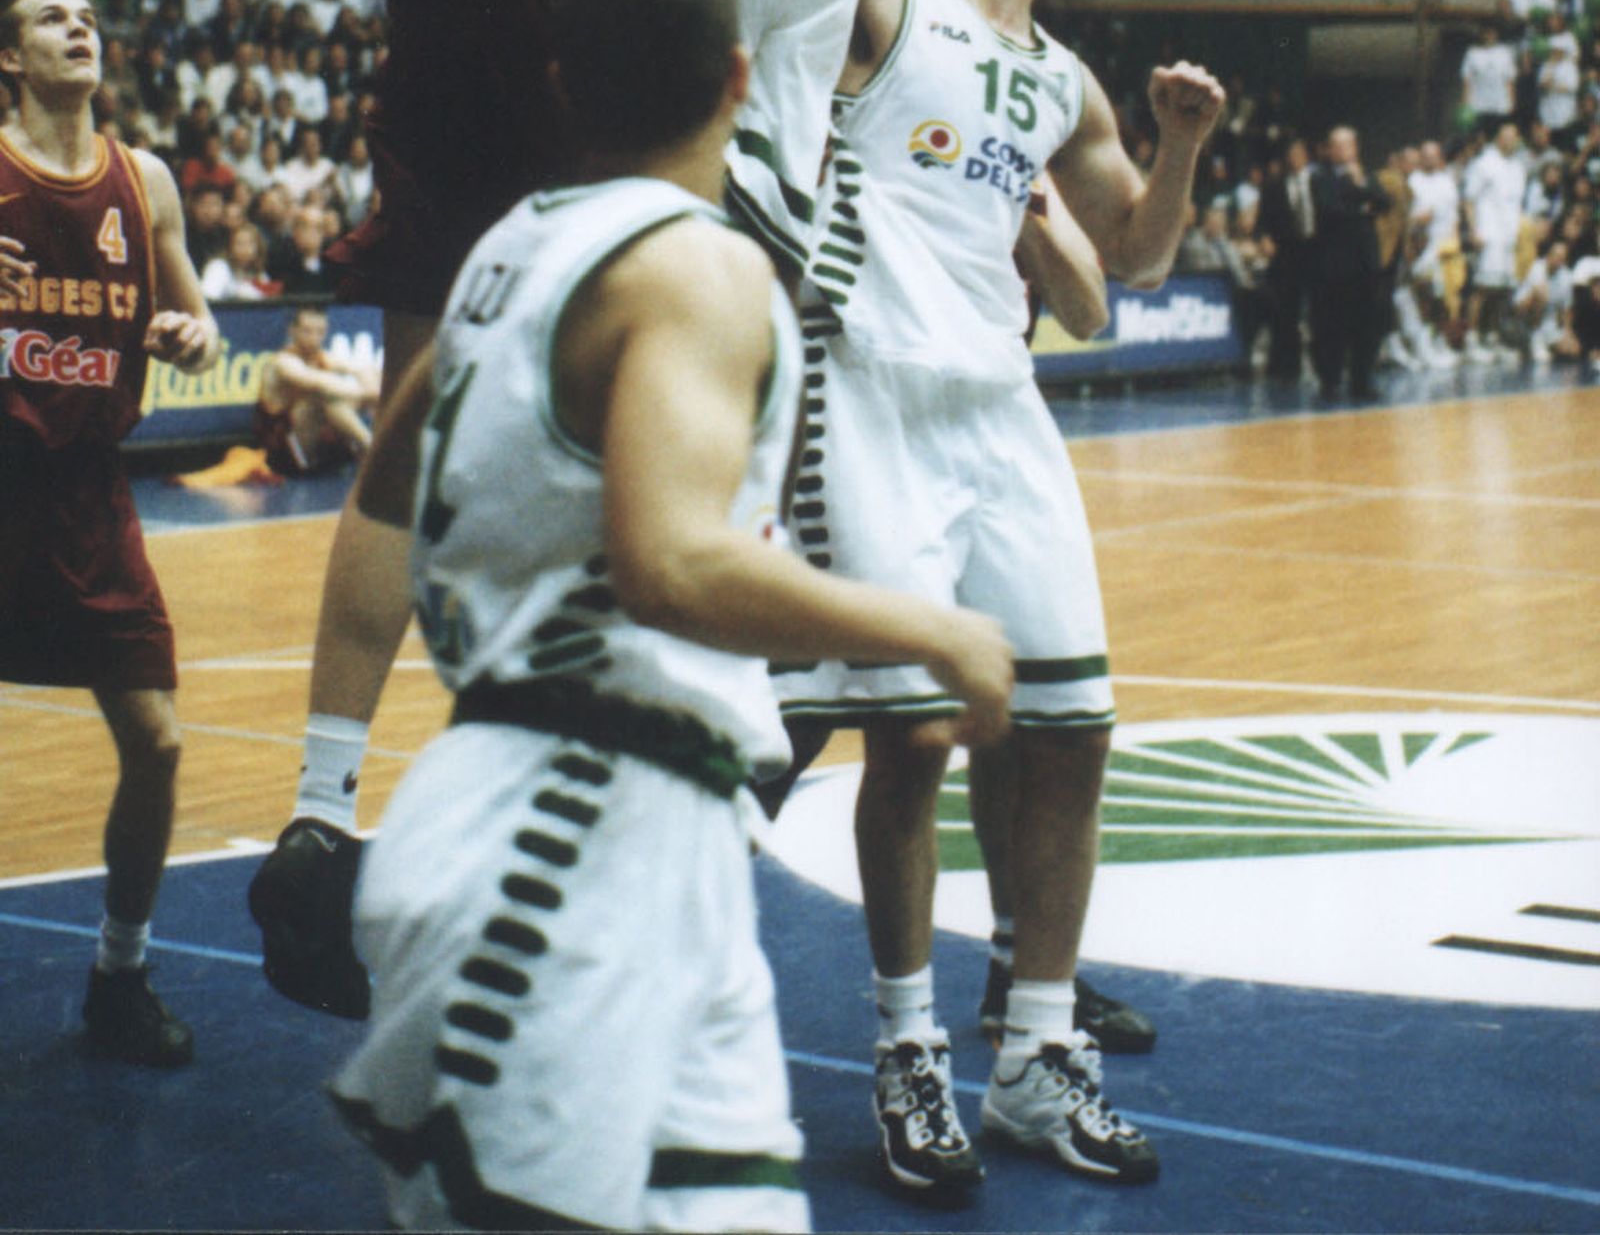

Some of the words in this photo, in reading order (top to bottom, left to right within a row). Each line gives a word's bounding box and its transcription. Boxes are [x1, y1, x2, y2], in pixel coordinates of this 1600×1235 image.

[928, 20, 972, 45] FILA
[974, 57, 1038, 134] 15
[97, 206, 128, 265] 4
